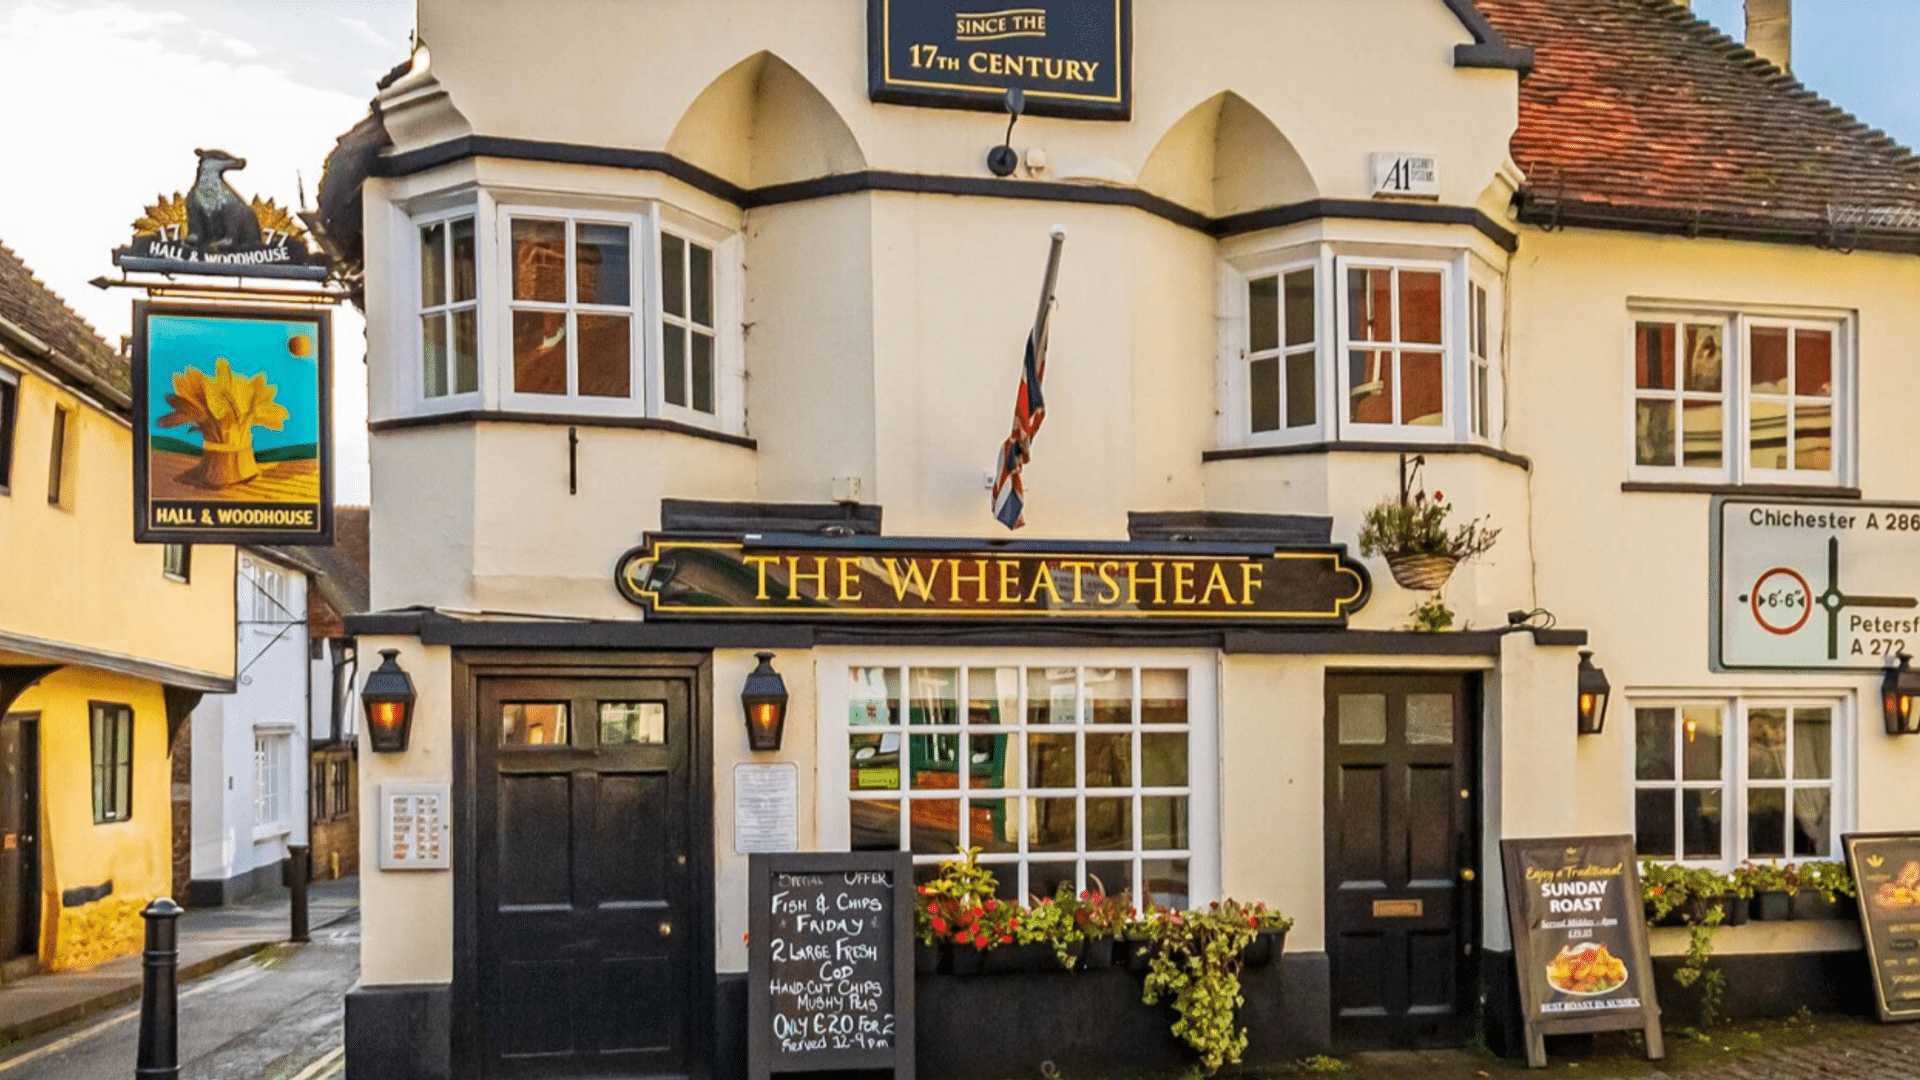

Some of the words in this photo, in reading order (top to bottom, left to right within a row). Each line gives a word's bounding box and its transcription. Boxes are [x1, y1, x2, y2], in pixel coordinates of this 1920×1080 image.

[956, 17, 1006, 34] SINCE
[1012, 15, 1046, 31] THE
[968, 52, 1099, 82] CENTURY
[160, 223, 180, 242] 17
[262, 228, 289, 247] 77
[149, 241, 183, 262] HALL
[189, 250, 199, 262] &
[204, 246, 290, 264] WOODHOUSE
[156, 507, 196, 524] HALL
[200, 508, 214, 525] &
[217, 508, 314, 525] WOODHOUSE
[1750, 508, 1856, 529] Chichester
[1866, 513, 1879, 529] A
[1886, 514, 1920, 531] 286
[743, 555, 863, 600] THE
[882, 557, 1264, 605] WHEATSHEAF
[1851, 638, 1863, 655] A
[1870, 638, 1906, 657] 272
[844, 871, 893, 889] OFFER
[1541, 880, 1608, 898] SUNDAY
[771, 890, 807, 914] FISH
[816, 892, 830, 916] &
[836, 892, 883, 911] CHIPS
[1549, 897, 1603, 914] ROAST
[796, 913, 863, 936] FRIDAY
[770, 938, 787, 963] 2
[790, 942, 831, 961] LARGE
[836, 937, 877, 965] FRESH
[819, 960, 853, 981] COD
[837, 979, 883, 998] CHIPS
[797, 993, 844, 1014] MUSHY
[813, 1012, 854, 1034] £20
[858, 1015, 881, 1035] FOR
[882, 1013, 895, 1035] 2
